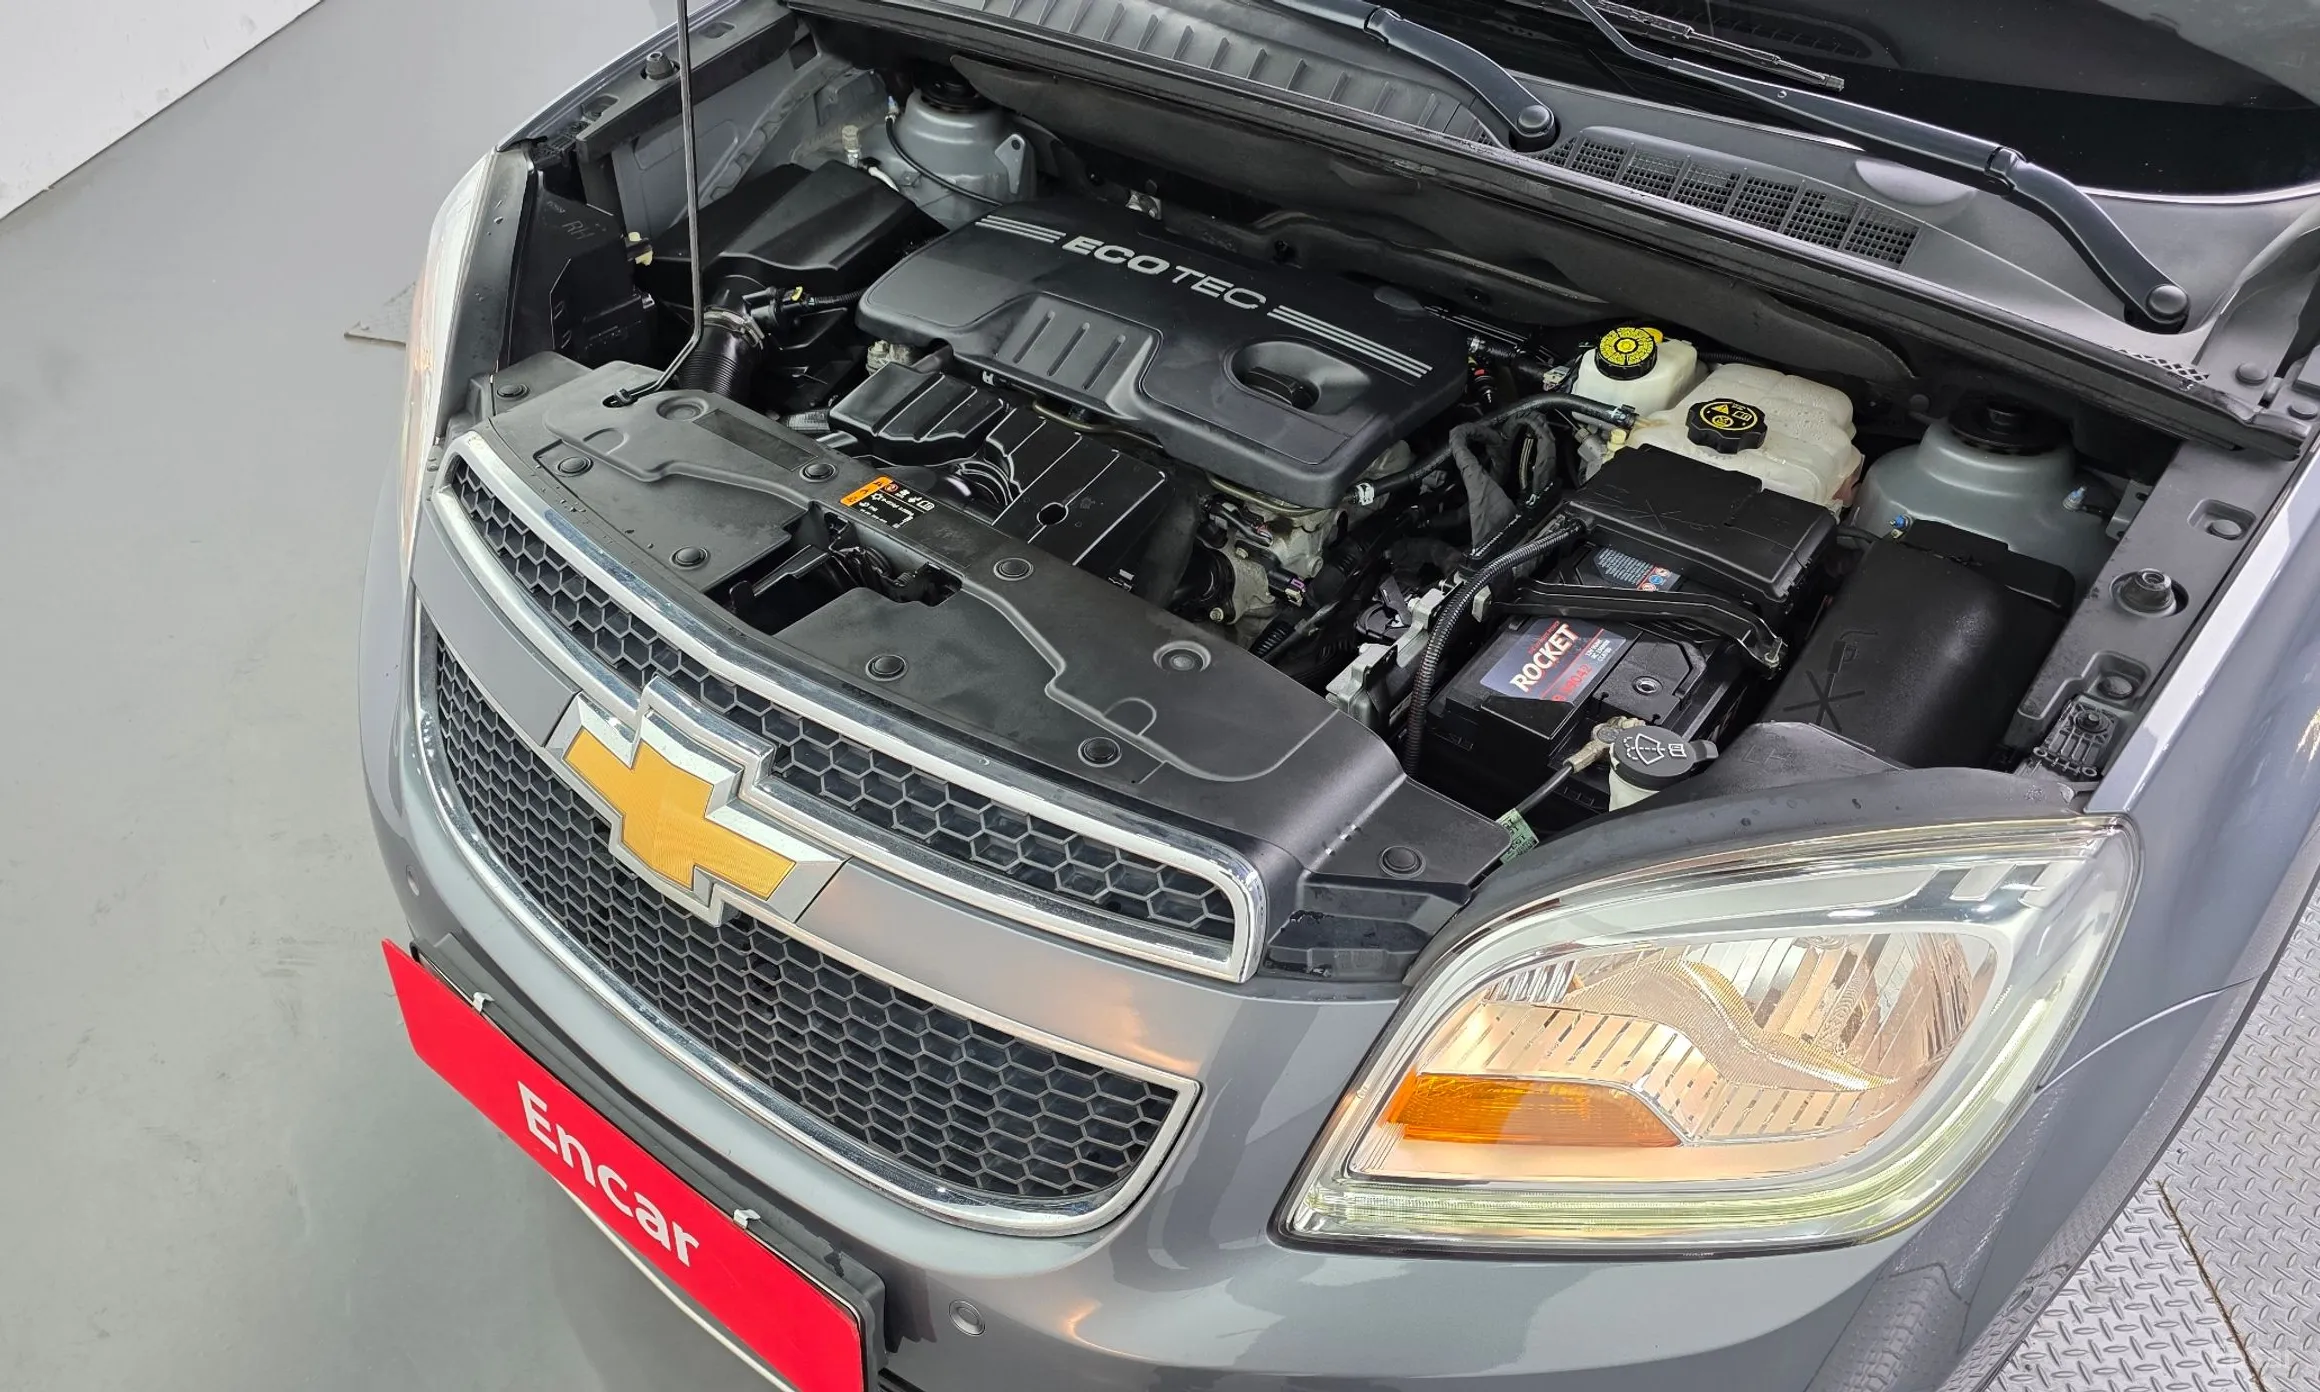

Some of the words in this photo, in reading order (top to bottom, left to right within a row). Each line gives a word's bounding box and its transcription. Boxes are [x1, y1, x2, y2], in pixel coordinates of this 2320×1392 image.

[1061, 235, 1267, 310] ECOTEC
[1509, 622, 1580, 693] ROCKET
[517, 1080, 700, 1268] Encar
